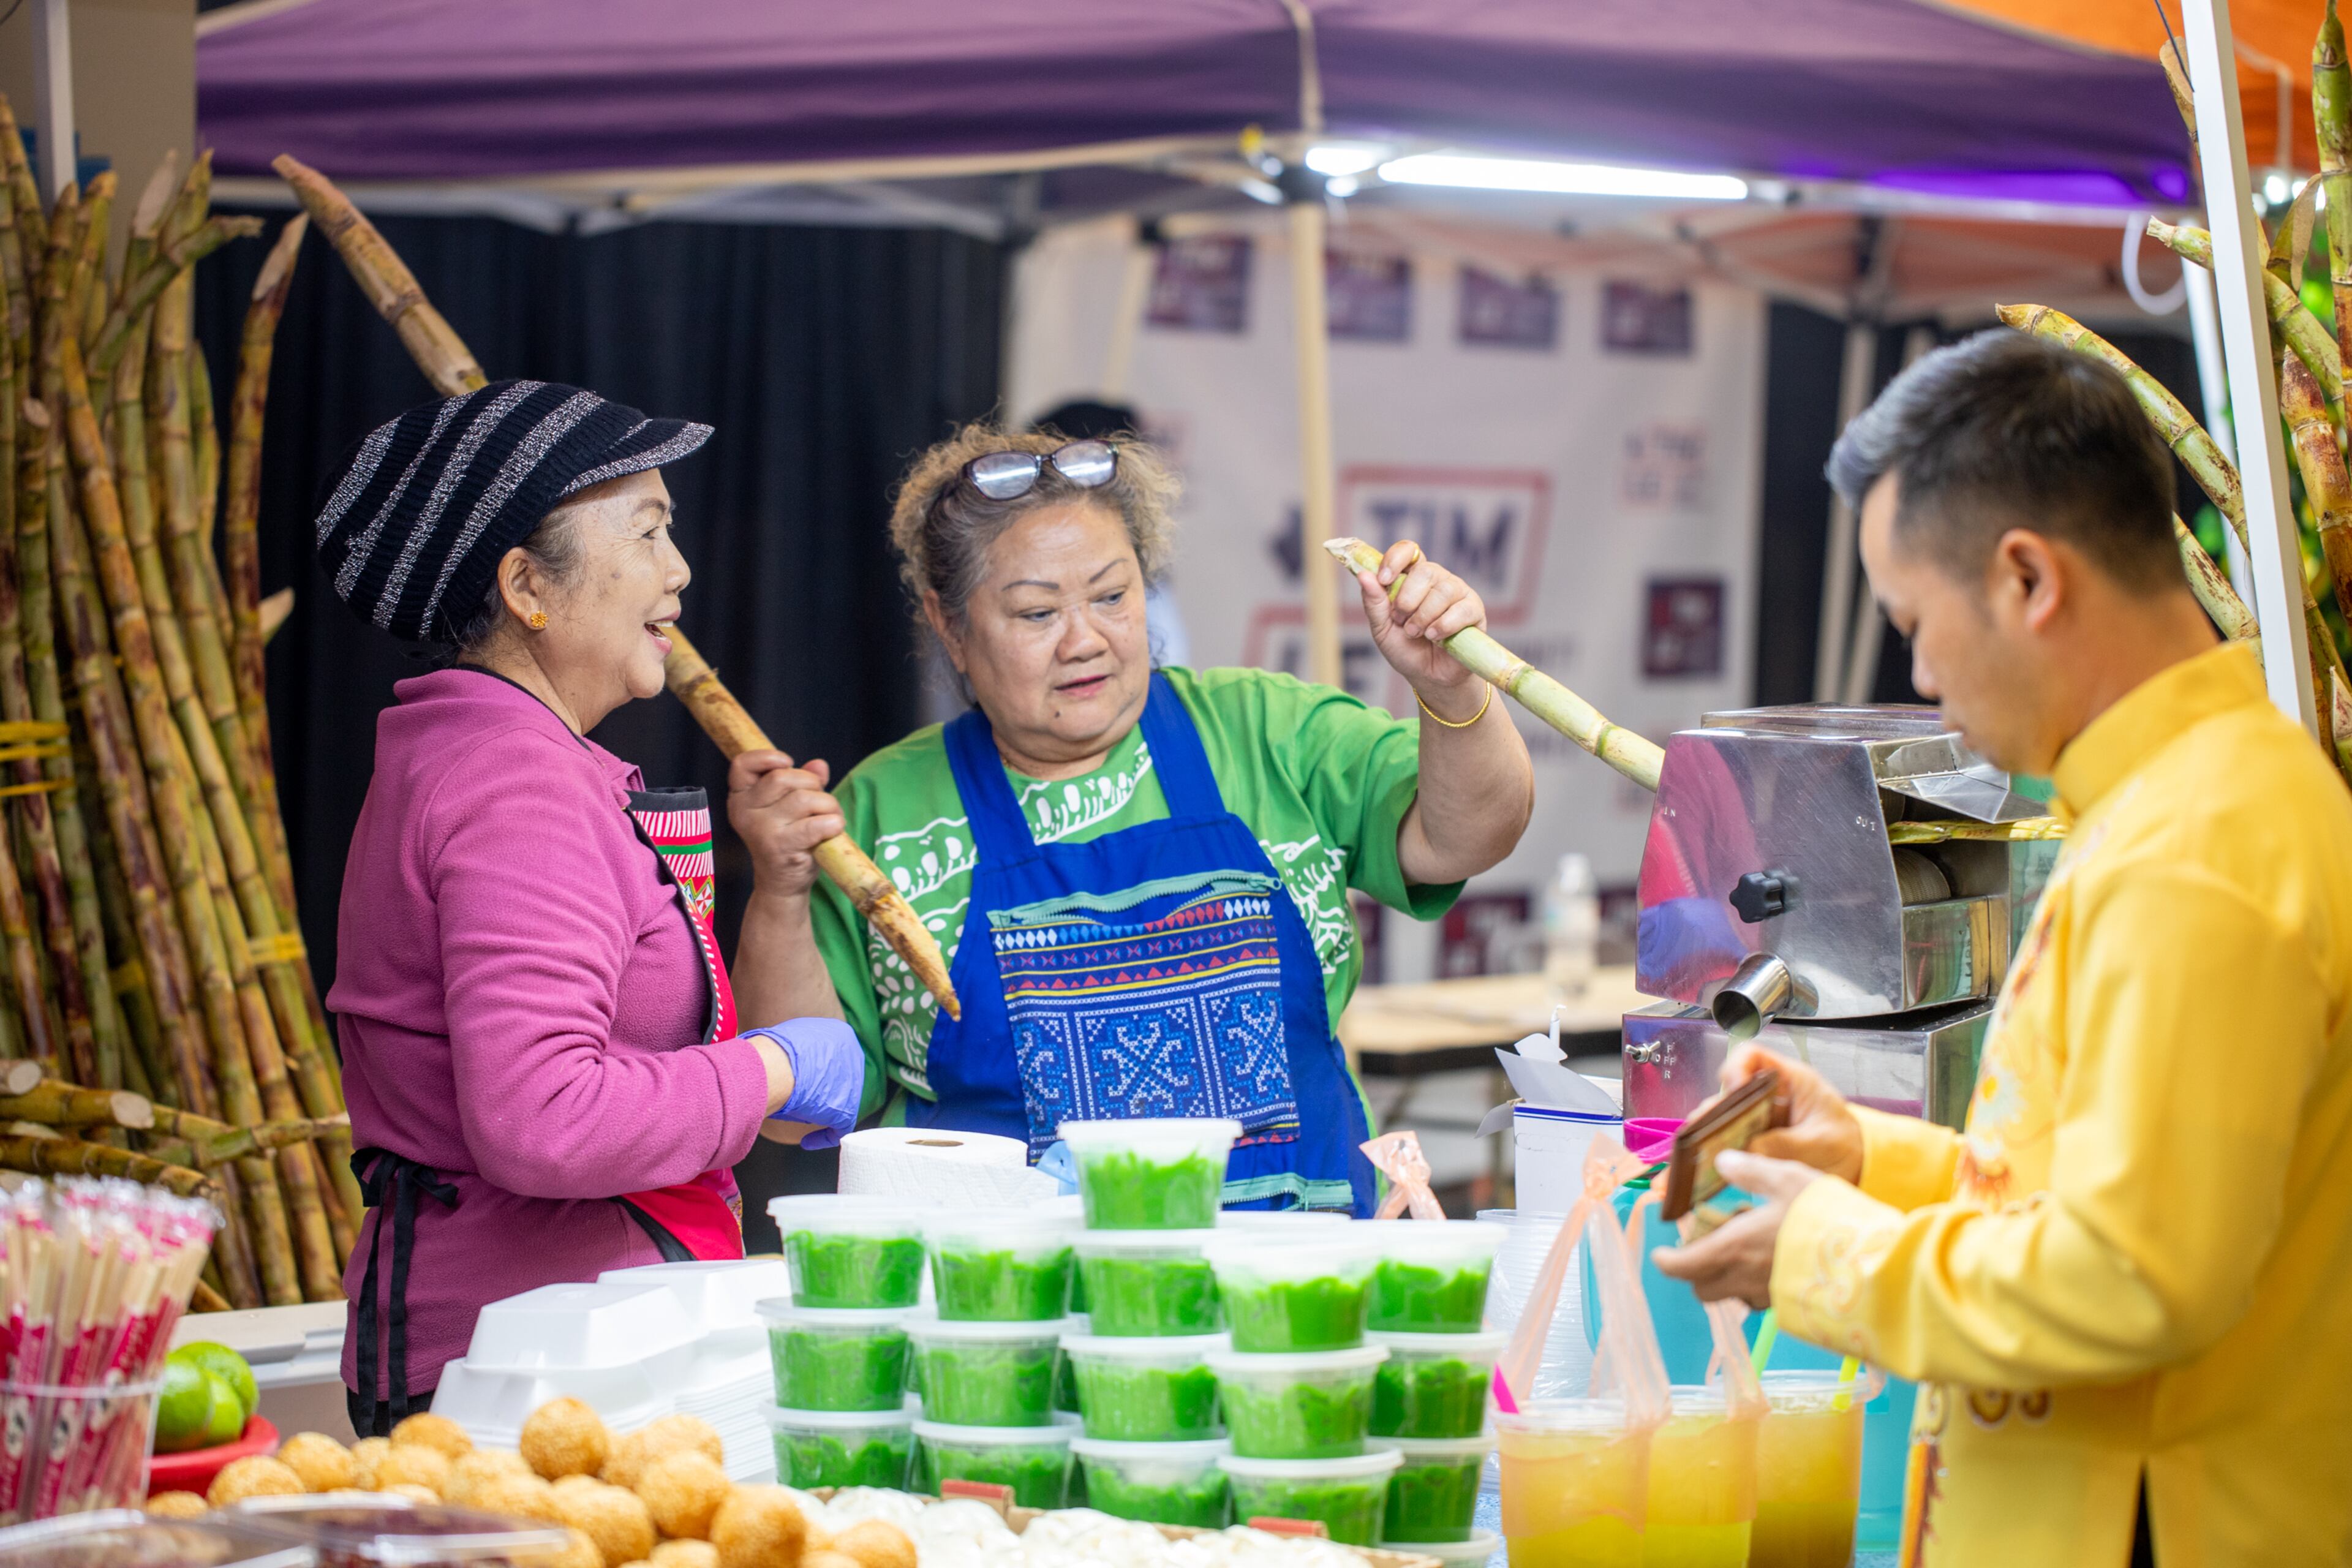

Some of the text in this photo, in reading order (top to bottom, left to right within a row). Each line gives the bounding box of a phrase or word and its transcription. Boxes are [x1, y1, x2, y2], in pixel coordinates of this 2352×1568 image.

[1369, 502, 1515, 591] TIM
[1664, 806, 1676, 817] IN
[1856, 816, 1875, 831] OUT
[1665, 1070, 1670, 1079] R
